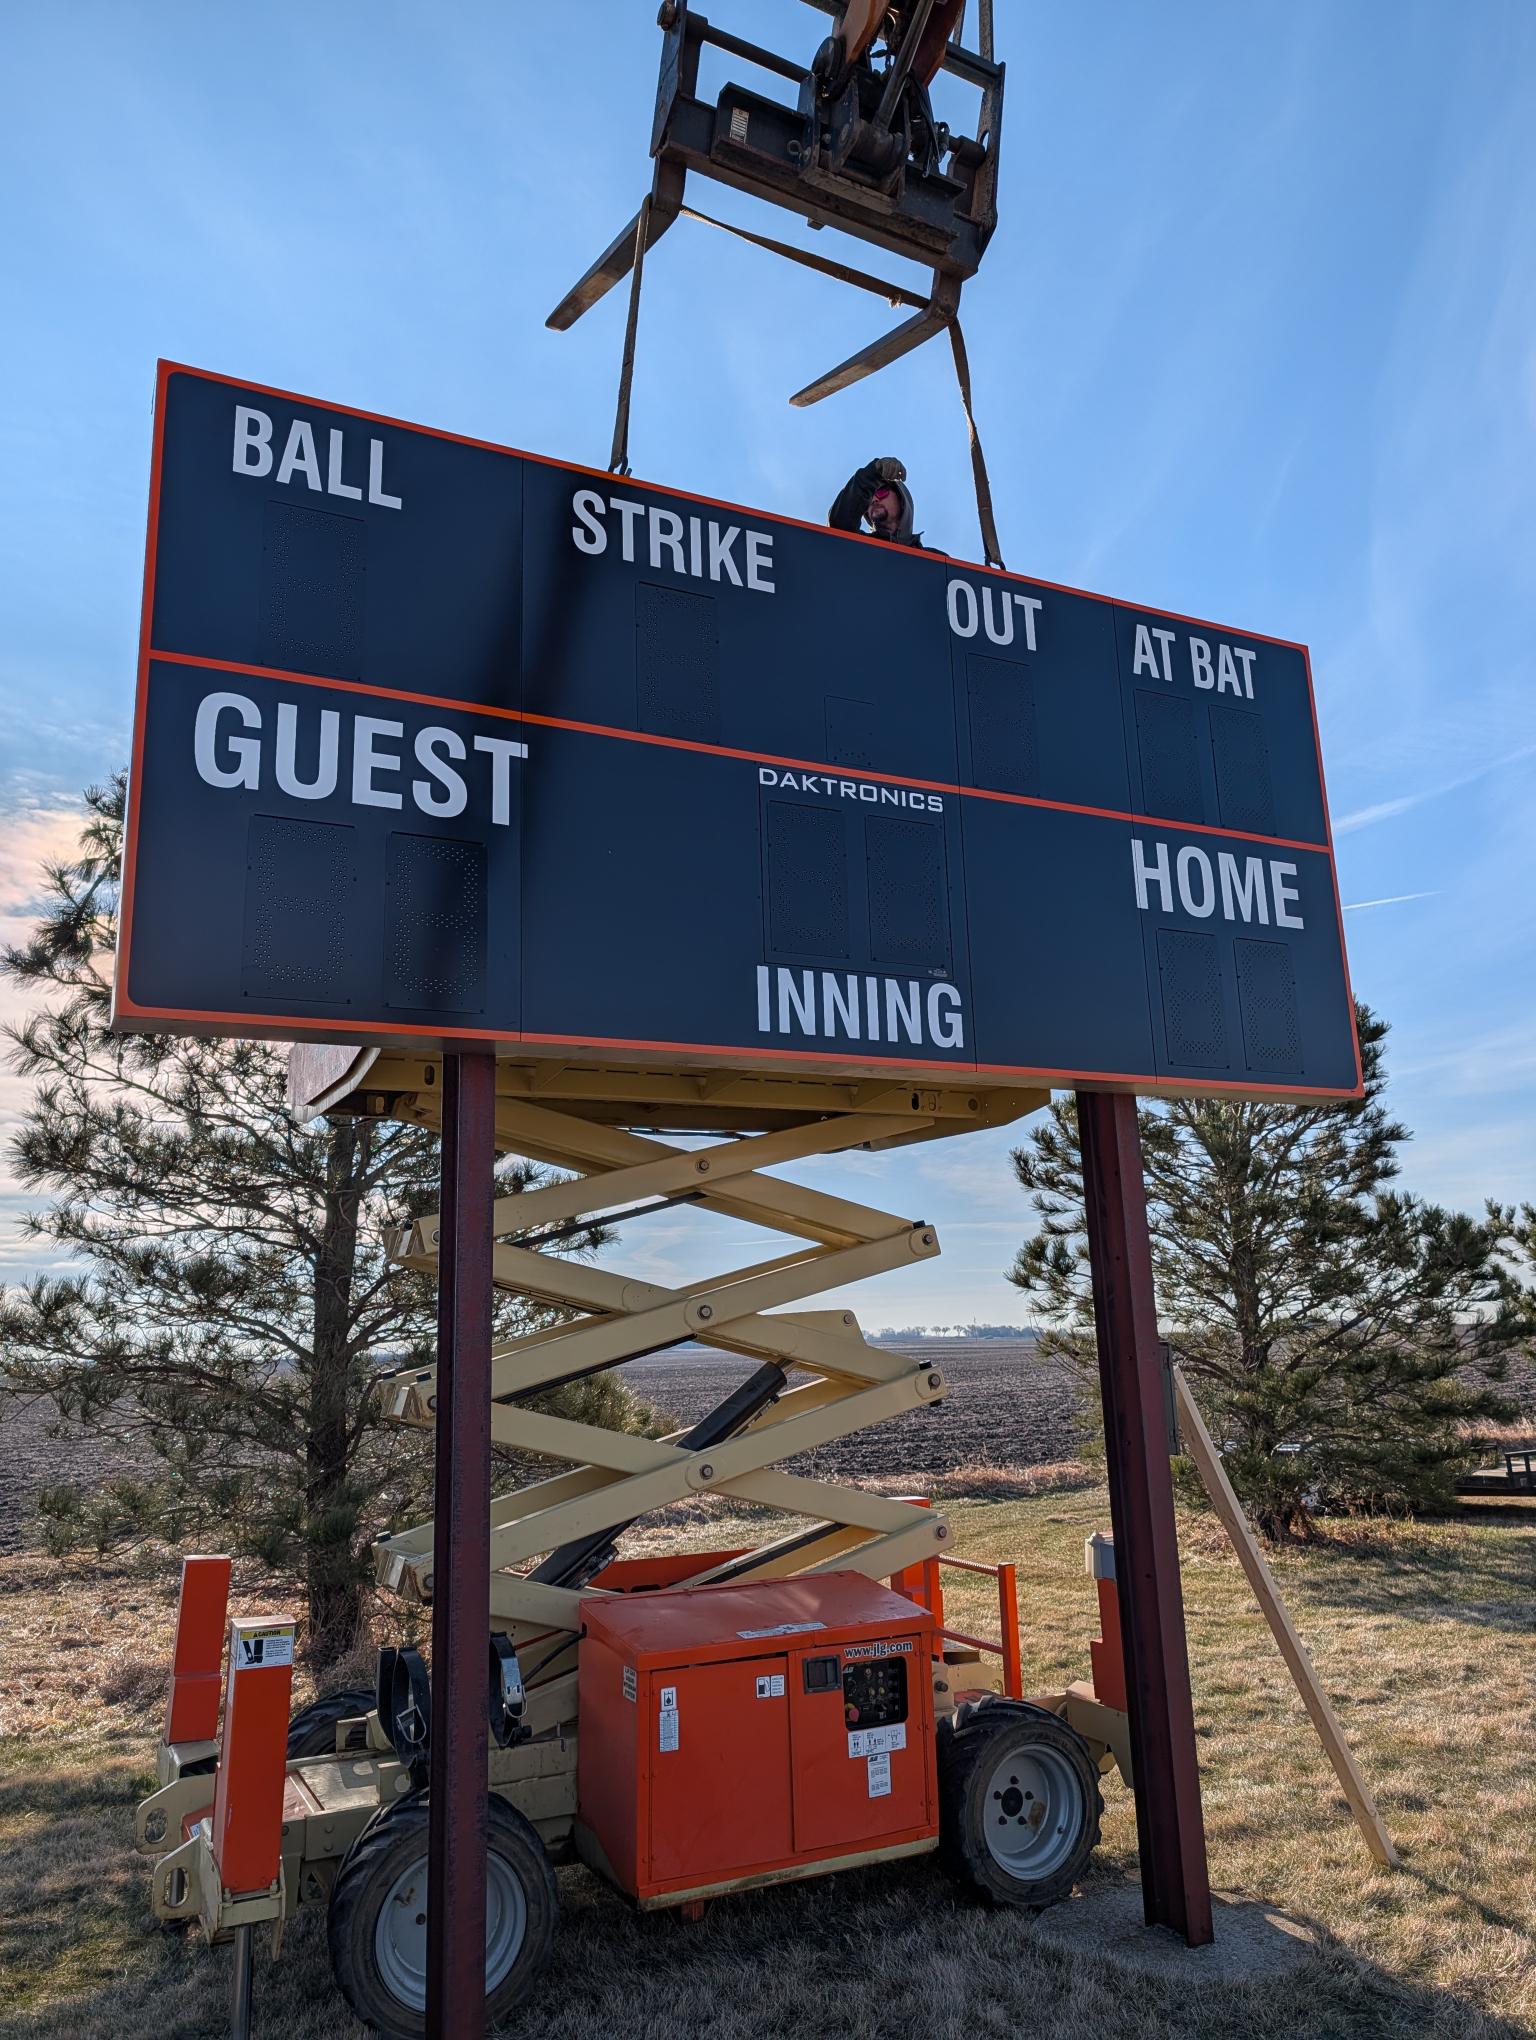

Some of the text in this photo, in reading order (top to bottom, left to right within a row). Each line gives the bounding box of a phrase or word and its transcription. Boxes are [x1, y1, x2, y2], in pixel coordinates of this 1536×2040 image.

[233, 406, 402, 509] BALL
[572, 490, 776, 594] STRIKE
[946, 579, 1043, 651] OUT
[1133, 624, 1256, 700] AT BAT
[194, 692, 529, 826] GUEST
[758, 767, 944, 813] DAKTRONICS
[1131, 839, 1304, 929] HOME
[757, 966, 964, 1048] INNING
[844, 1642, 913, 1658] www.jlg.com
